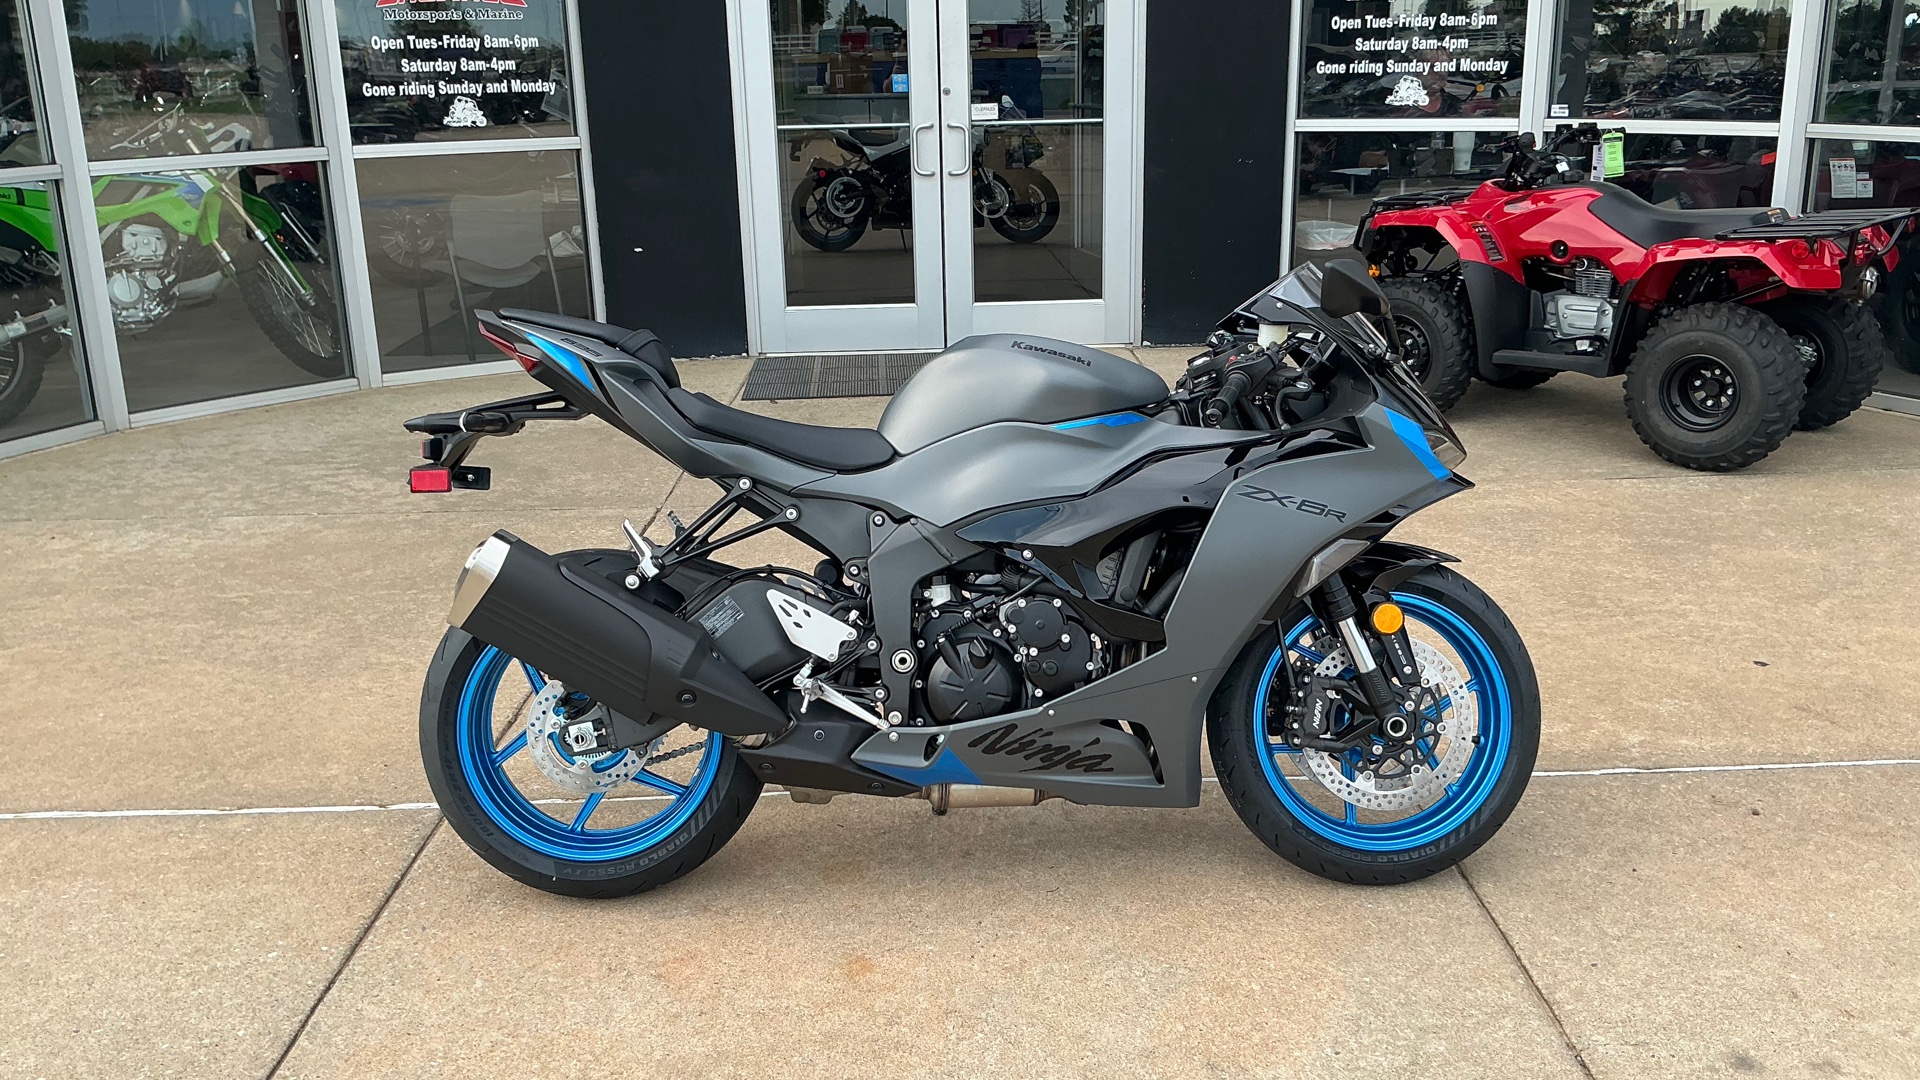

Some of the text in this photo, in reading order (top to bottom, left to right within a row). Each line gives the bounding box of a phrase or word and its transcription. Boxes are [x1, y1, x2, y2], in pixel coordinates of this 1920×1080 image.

[383, 8, 523, 23] Motorsports & Marine
[1331, 12, 1498, 32] Open Tues-Friday 8am-6pm
[371, 35, 539, 53] Open Tues-Friday 8am-6pm
[1355, 36, 1469, 54] Saturday 8am-4pm
[401, 57, 516, 75] Saturday 8am-4pm
[1316, 57, 1509, 76] Gone riding Sunday and Monday
[362, 78, 556, 98] Gone riding Sunday and Monday
[1010, 340, 1092, 367] Kawasaki
[1236, 484, 1347, 524] ZX-6R
[967, 722, 1115, 773] Ninja
[639, 832, 689, 867] DIABLO
[1376, 846, 1437, 863] DIABLO
[587, 861, 636, 877] ROSSO
